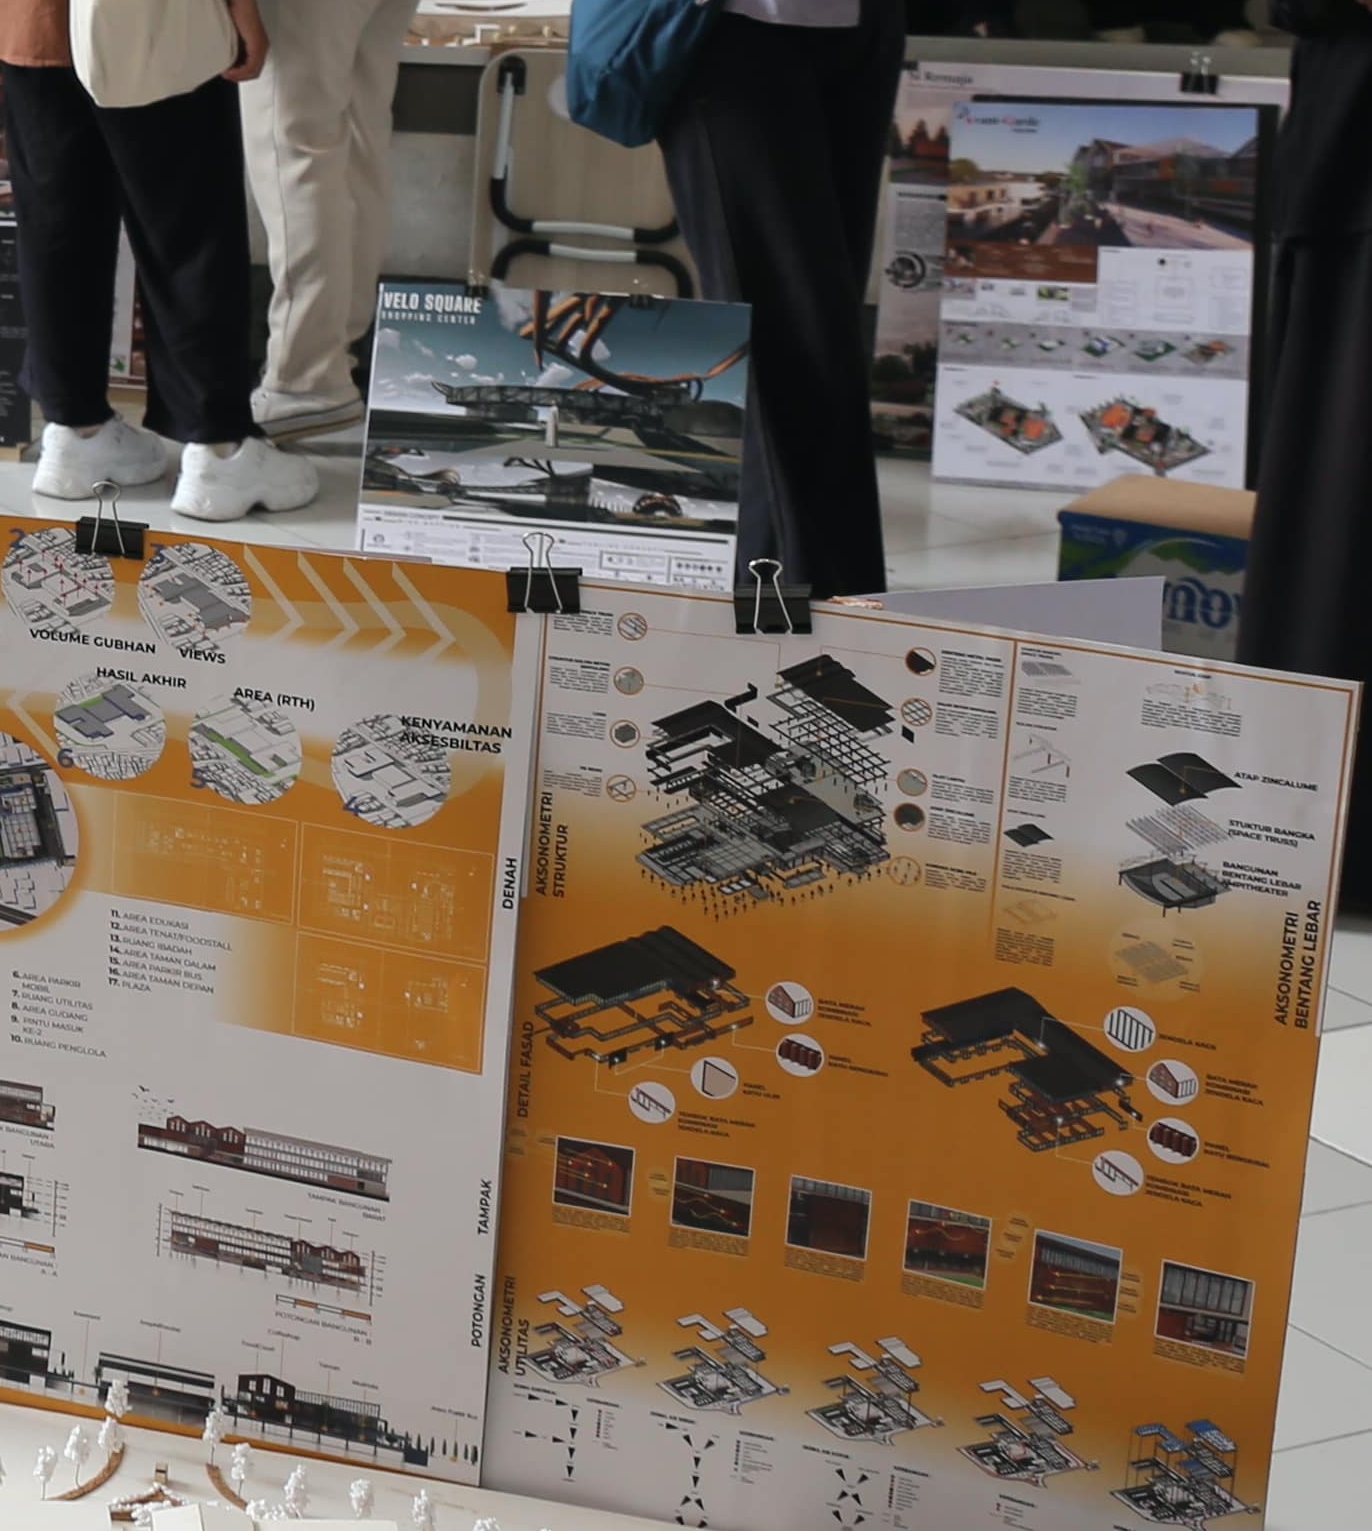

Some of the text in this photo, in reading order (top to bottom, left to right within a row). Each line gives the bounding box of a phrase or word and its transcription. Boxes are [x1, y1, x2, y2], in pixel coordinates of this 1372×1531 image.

[384, 292, 482, 314] VELO SQUARE
[381, 311, 477, 325] SHOPPING CENTER
[30, 629, 156, 654] VOLUME GUBHAN
[178, 648, 226, 665] VIEWS
[96, 667, 187, 689] HASIL AKHIR
[234, 687, 315, 712] AREA (RTH)
[400, 715, 512, 740] KENYAMANAN
[400, 732, 502, 755] AKSESBILTAS
[58, 748, 74, 767] 6
[1234, 770, 1318, 793] ATAP ZINCALUME
[535, 791, 553, 896] AKSONOMETRI
[1274, 826, 1315, 841] RANGKA
[553, 824, 569, 899] STRUKTUR
[1223, 860, 1278, 877] BANGUNAN
[502, 857, 517, 910] DENAH
[1221, 869, 1302, 890] BENTANG LEBAR
[123, 912, 147, 923] AREA
[123, 923, 147, 935] AREA
[122, 937, 155, 949] RUANG
[122, 959, 148, 971] AREA
[123, 948, 148, 960] AREA
[150, 952, 182, 966] TAMAN
[1295, 899, 1321, 1030] BENTANG LEBAR
[22, 972, 46, 983] AREA
[122, 971, 181, 988] AREA TAMAN
[1275, 912, 1299, 1026] AKSONOMETRI
[122, 981, 151, 993] PLAZA
[22, 992, 93, 1011] RUANG UTILITAS
[23, 1003, 88, 1022] AREA GUDANG
[23, 1016, 84, 1033] PINTU MASUK
[24, 1036, 57, 1050] RUANG
[517, 1021, 535, 1118] DETAIL FASAD
[478, 1180, 492, 1236] TAMPAK
[471, 1274, 485, 1347] POTONGAN
[498, 1276, 516, 1374] AKSONOMETRI
[515, 1320, 529, 1376] UTILITAS
